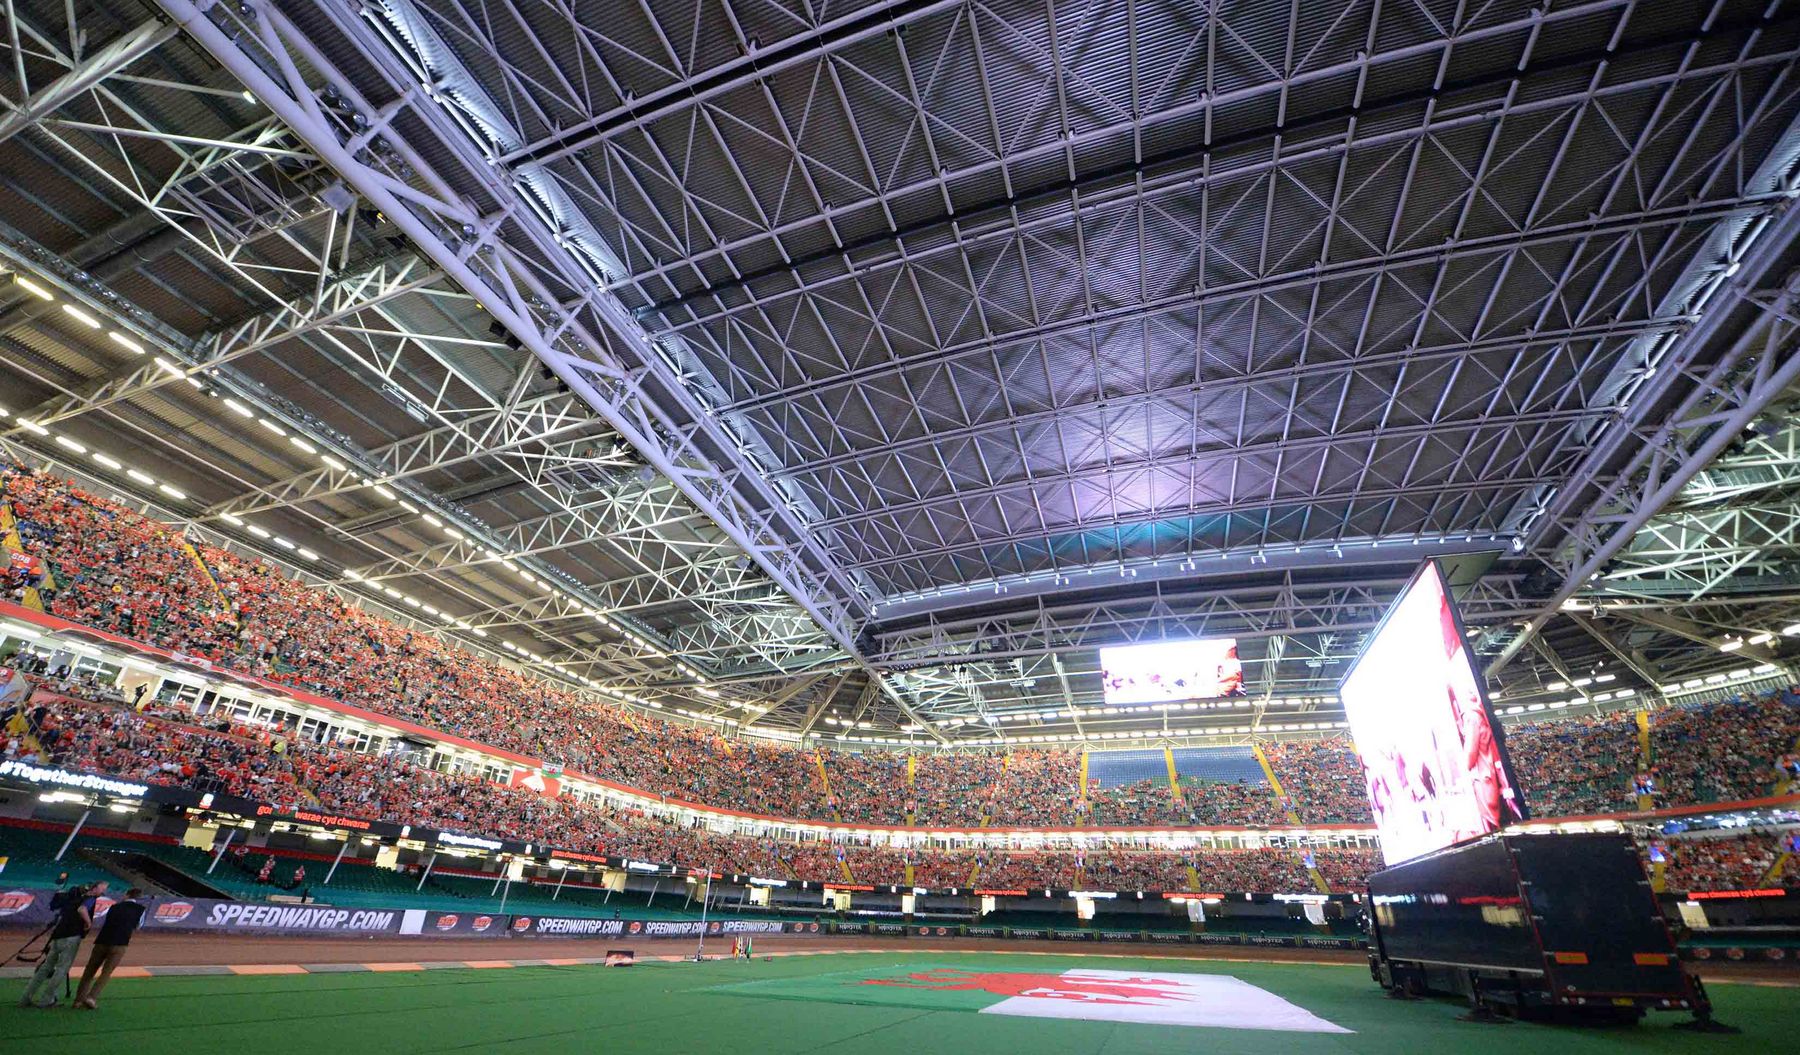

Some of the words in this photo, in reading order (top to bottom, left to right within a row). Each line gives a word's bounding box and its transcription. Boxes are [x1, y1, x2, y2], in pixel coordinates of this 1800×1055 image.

[206, 903, 394, 930] SPEEDWAYGP.COM
[536, 917, 624, 934] SPEEDWAYGP.COM
[645, 921, 707, 935] SPEEDWAYGP.COM
[722, 920, 782, 933] SPEEDWAYGP.COM
